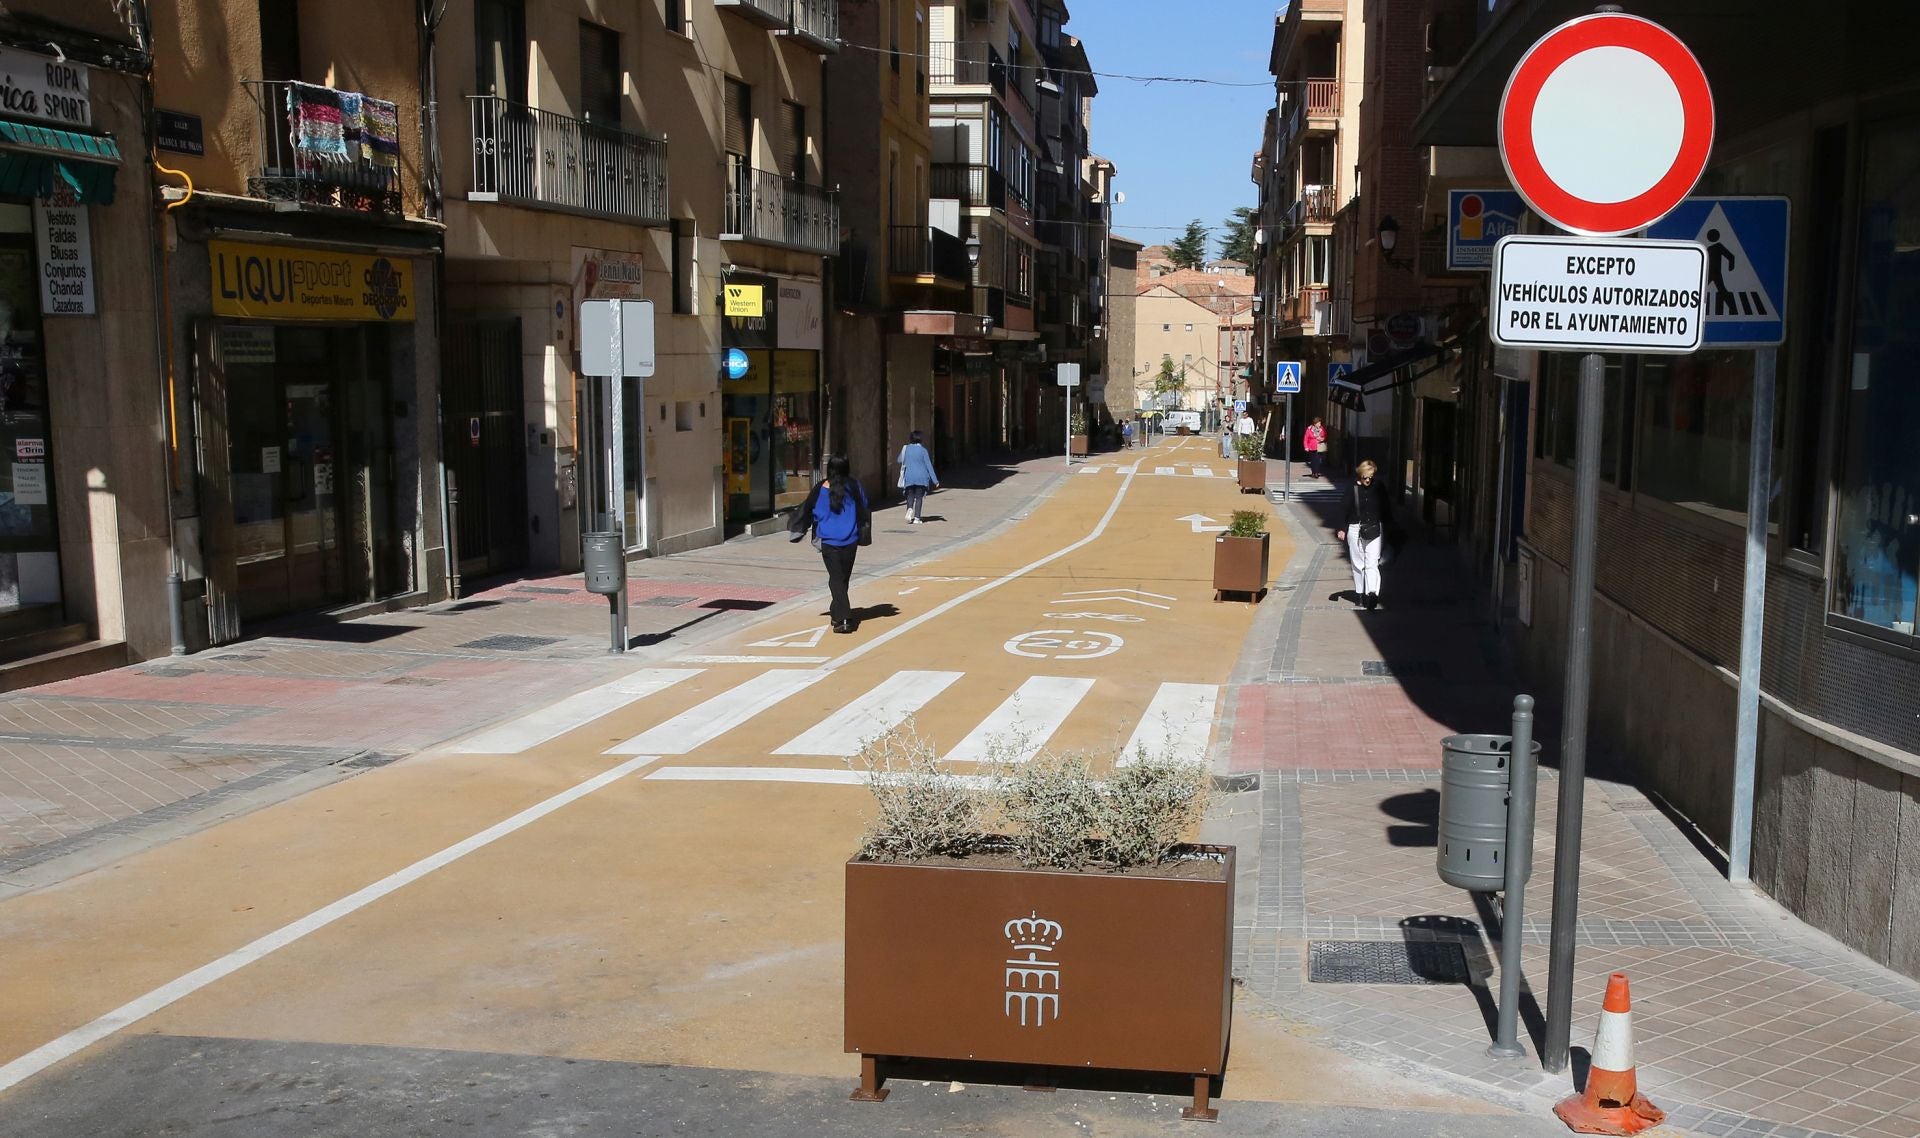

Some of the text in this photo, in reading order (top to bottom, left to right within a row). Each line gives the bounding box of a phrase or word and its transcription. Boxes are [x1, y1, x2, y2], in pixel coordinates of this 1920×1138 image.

[46, 63, 80, 92] ROPA
[44, 93, 85, 121] SPORT
[158, 136, 178, 147] BLANCA
[180, 139, 187, 149] DE
[46, 210, 77, 225] Vestidos
[49, 227, 77, 243] Faldas
[50, 245, 78, 260] Blusas
[45, 262, 86, 280] Conjuntos
[599, 260, 641, 282] Jenni Nails
[1566, 256, 1636, 276] EXCEPTO
[49, 280, 84, 295] Chandal
[1503, 280, 1701, 309] VEHÍCULOS AUTORIZADOS
[52, 297, 84, 313] Cazadoras
[301, 292, 333, 307] Deportes
[1510, 310, 1688, 335] POR EL AYUNTAMIENTO
[1019, 636, 1102, 650] 20
